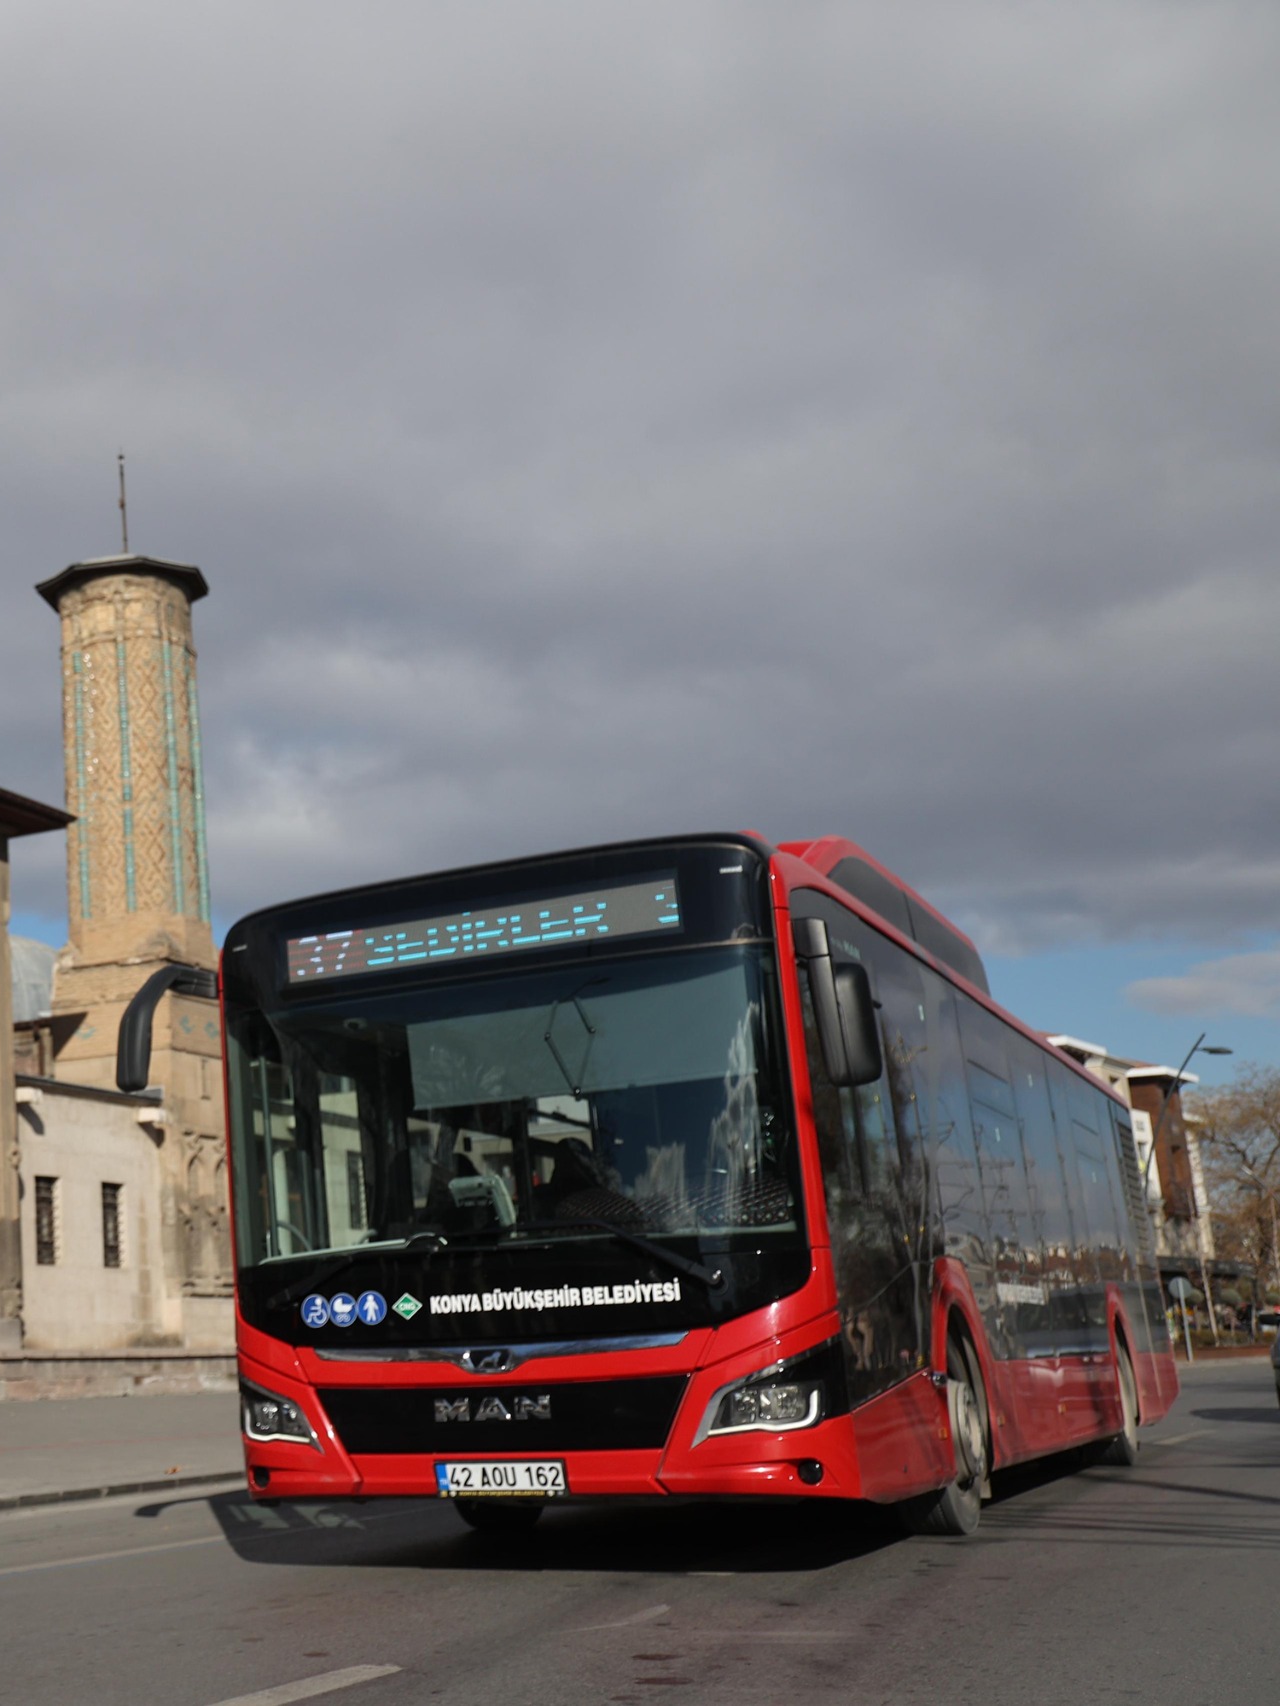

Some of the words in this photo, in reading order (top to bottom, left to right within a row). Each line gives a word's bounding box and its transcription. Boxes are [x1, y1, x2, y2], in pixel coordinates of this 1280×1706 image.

[430, 1293, 482, 1314] KONYA
[482, 1284, 581, 1312] BÜYÜKŞEHİR
[582, 1277, 681, 1306] BELEDİYESİ
[434, 1394, 551, 1422] MAN
[450, 1466, 474, 1488] 42
[481, 1466, 517, 1488] AOU
[524, 1466, 562, 1488] 162
